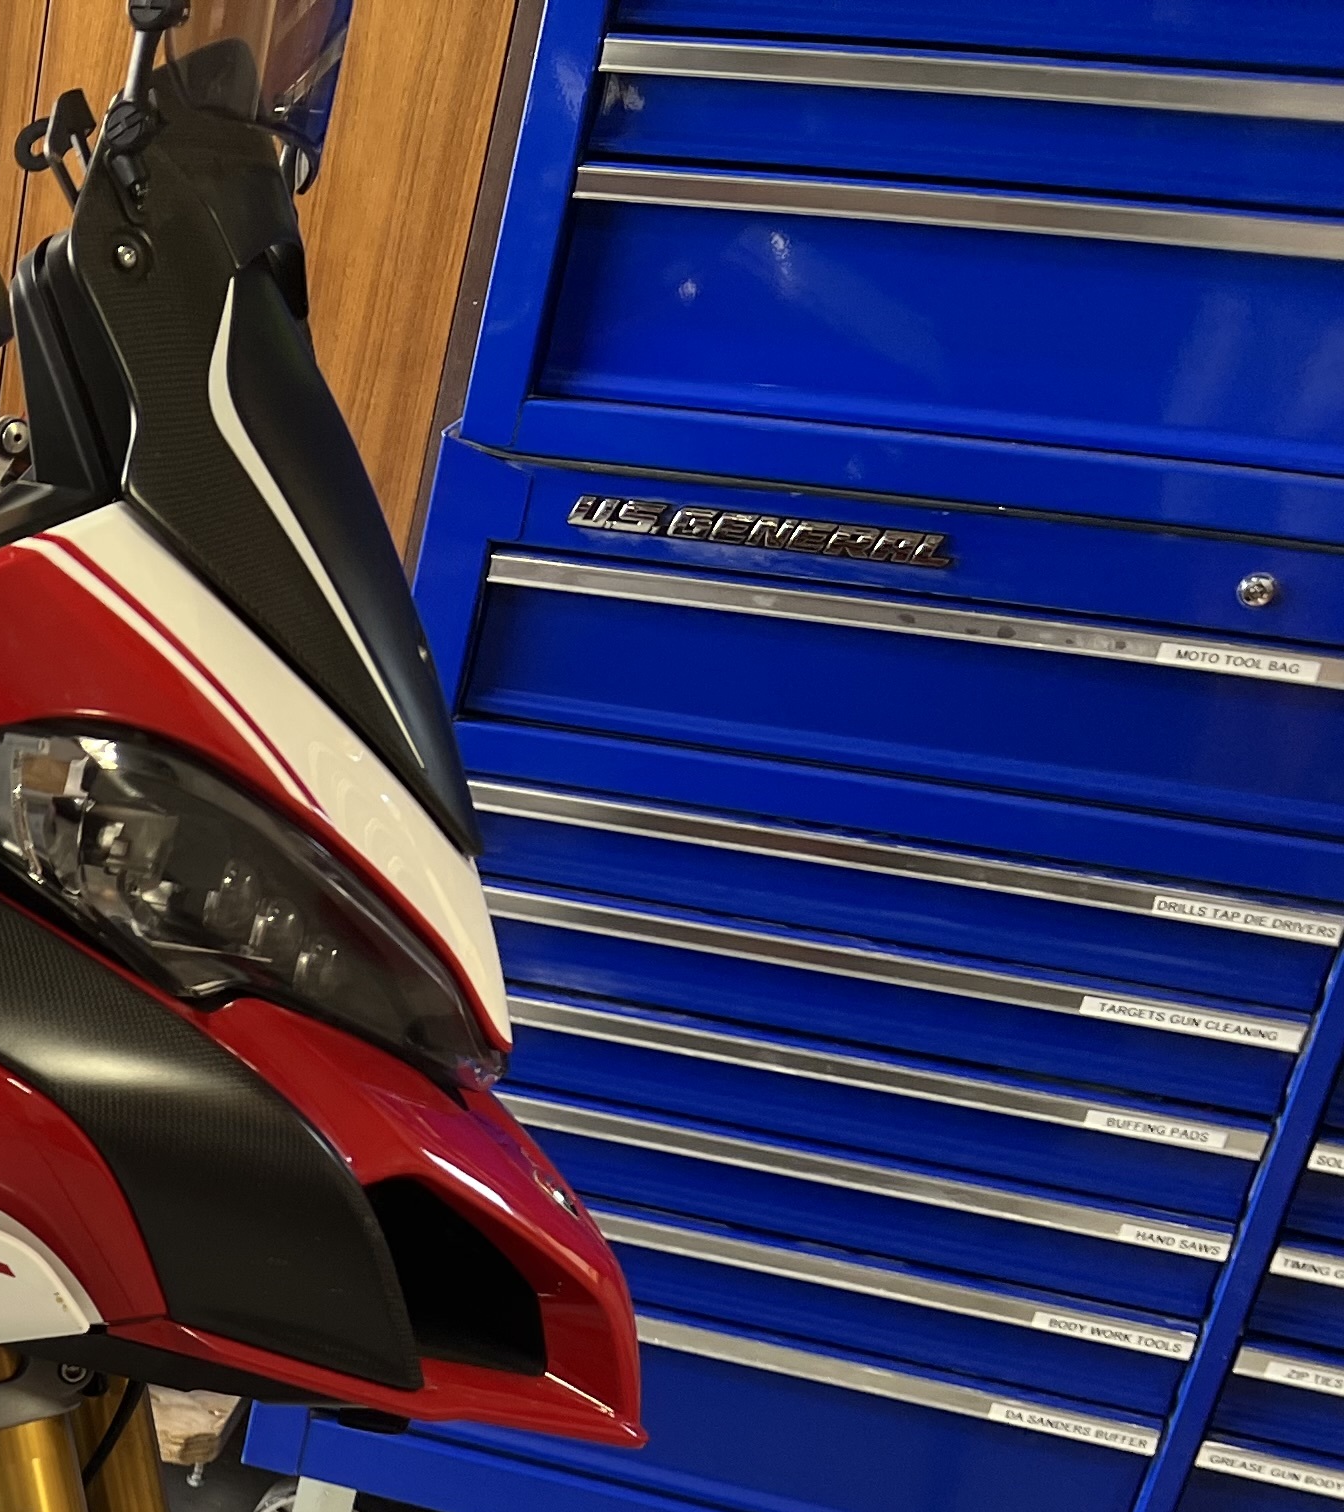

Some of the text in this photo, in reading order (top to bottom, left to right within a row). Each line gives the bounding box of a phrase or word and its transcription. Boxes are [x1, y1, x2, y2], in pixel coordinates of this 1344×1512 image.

[666, 505, 955, 569] GENERAL
[1175, 649, 1300, 675] MOTO TOOL BAG
[1156, 900, 1337, 939] DRILLS TAP DIE DRIVERS
[1098, 1002, 1279, 1041] TARGETS GUN CLEANING
[1106, 1117, 1211, 1143] BUFFING PADS
[1135, 1230, 1222, 1256] HAND SAWS
[1283, 1257, 1331, 1276] TIMING
[1048, 1317, 1184, 1353] BODY WORK TOOLS
[1004, 1409, 1149, 1449] DA SANDERS BUFFER
[1209, 1454, 1266, 1474] GREASE
[1270, 1468, 1302, 1481] GUN
